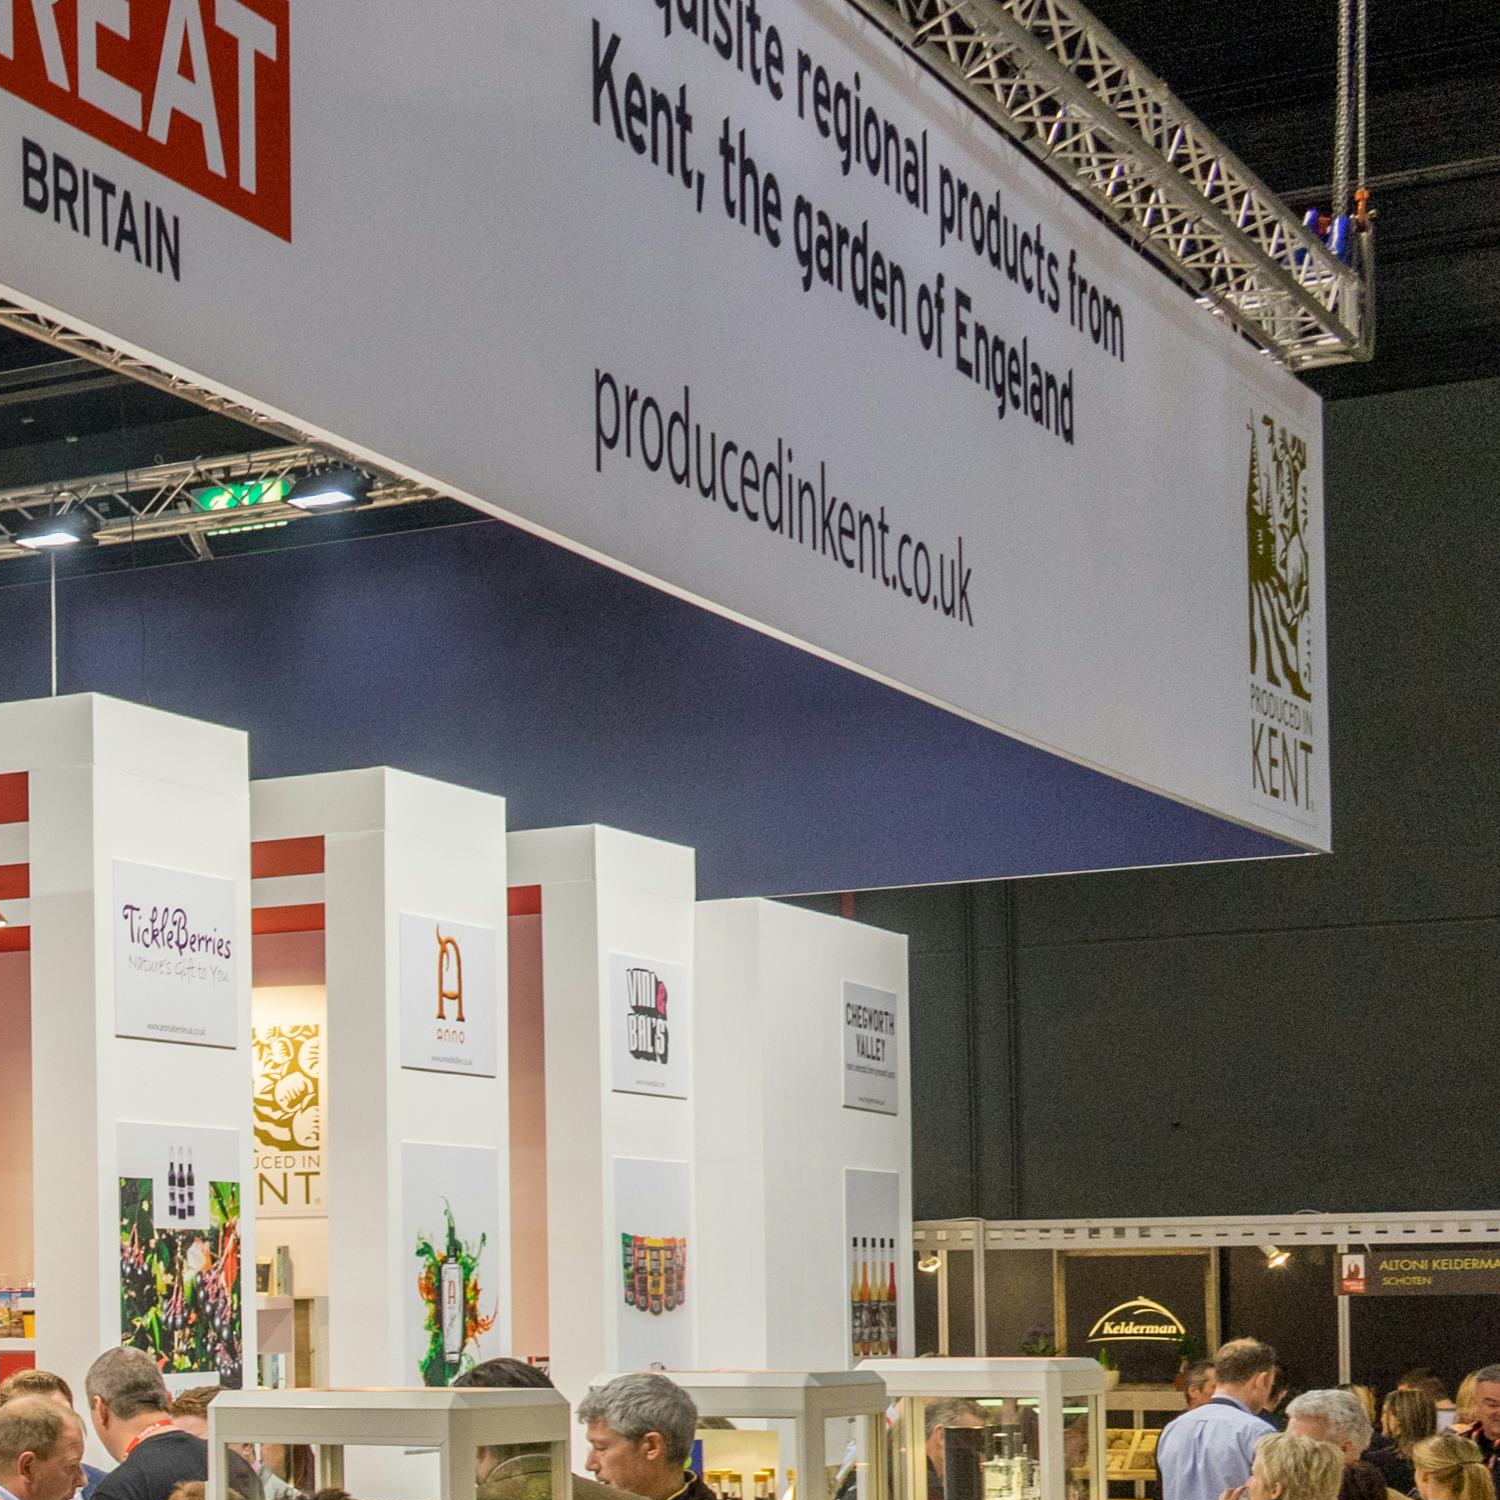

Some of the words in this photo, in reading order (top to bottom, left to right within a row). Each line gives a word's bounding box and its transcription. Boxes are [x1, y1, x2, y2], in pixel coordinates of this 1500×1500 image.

[22, 136, 181, 282] BRITAIN
[798, 48, 928, 214] regional
[939, 163, 1060, 315] products
[1067, 248, 1125, 363] from
[591, 18, 705, 214] Kent,
[718, 115, 782, 249] the
[793, 193, 908, 336] garden
[916, 272, 946, 360] of
[954, 286, 1075, 446] Engeland
[594, 367, 974, 628] producedinkent.co.uk
[1251, 683, 1301, 731] PRODUCED
[1252, 718, 1314, 811] KENT
[123, 904, 231, 959] TickleBerries
[846, 1002, 894, 1036] CHEGWORTH
[856, 1033, 886, 1062] VALLEY
[303, 1155, 320, 1168] IN
[1379, 1258, 1428, 1271] ALTONI
[1382, 1276, 1432, 1285] SCHOTEN
[1102, 1321, 1178, 1335] Kelderman
